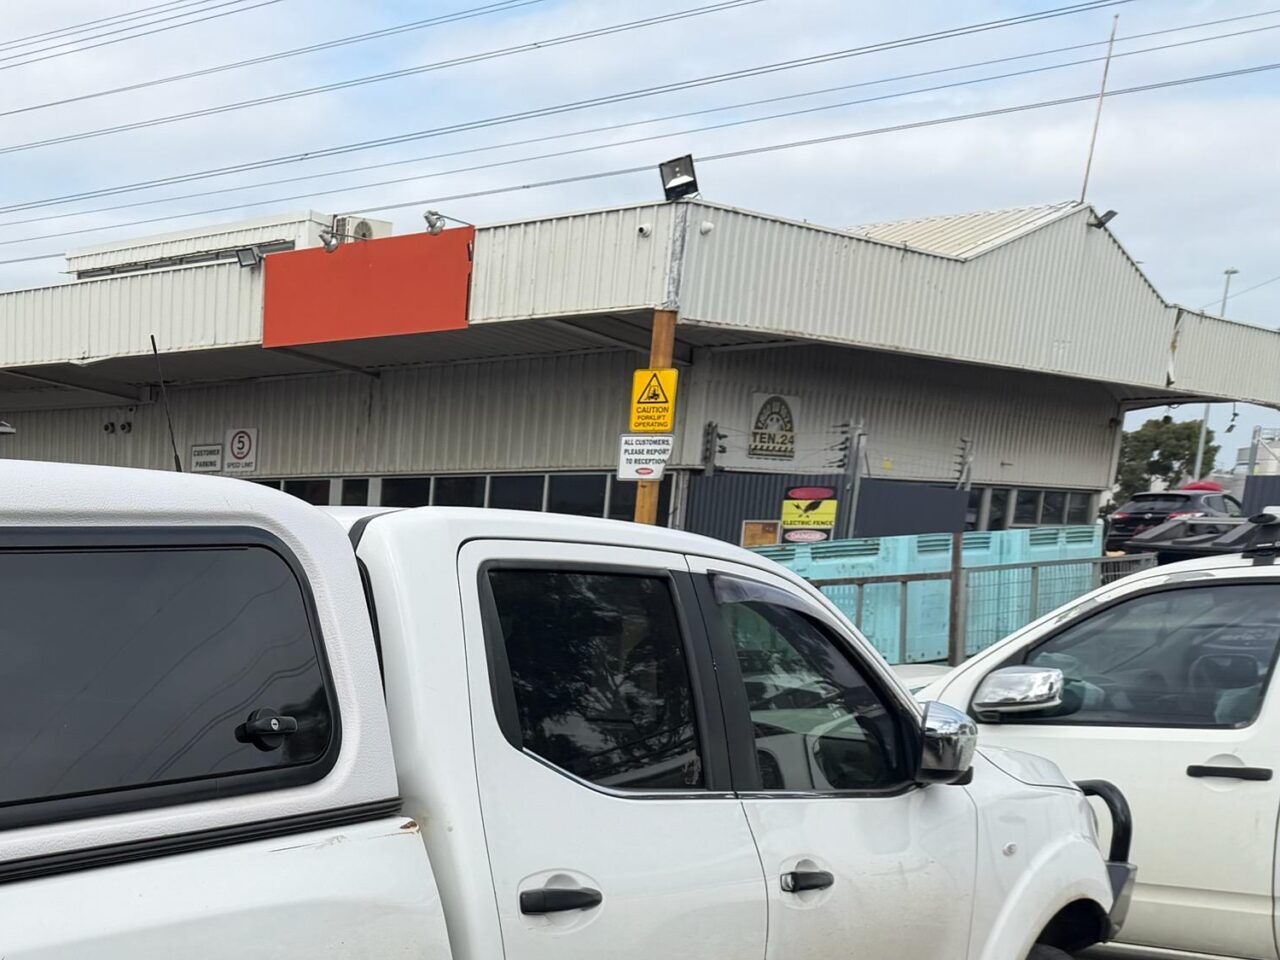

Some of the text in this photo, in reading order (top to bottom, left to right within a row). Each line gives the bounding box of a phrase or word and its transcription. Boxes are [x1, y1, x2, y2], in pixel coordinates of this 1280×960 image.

[636, 406, 670, 414] CAUTION
[236, 435, 246, 451] 5
[193, 449, 220, 457] CUSTOMER
